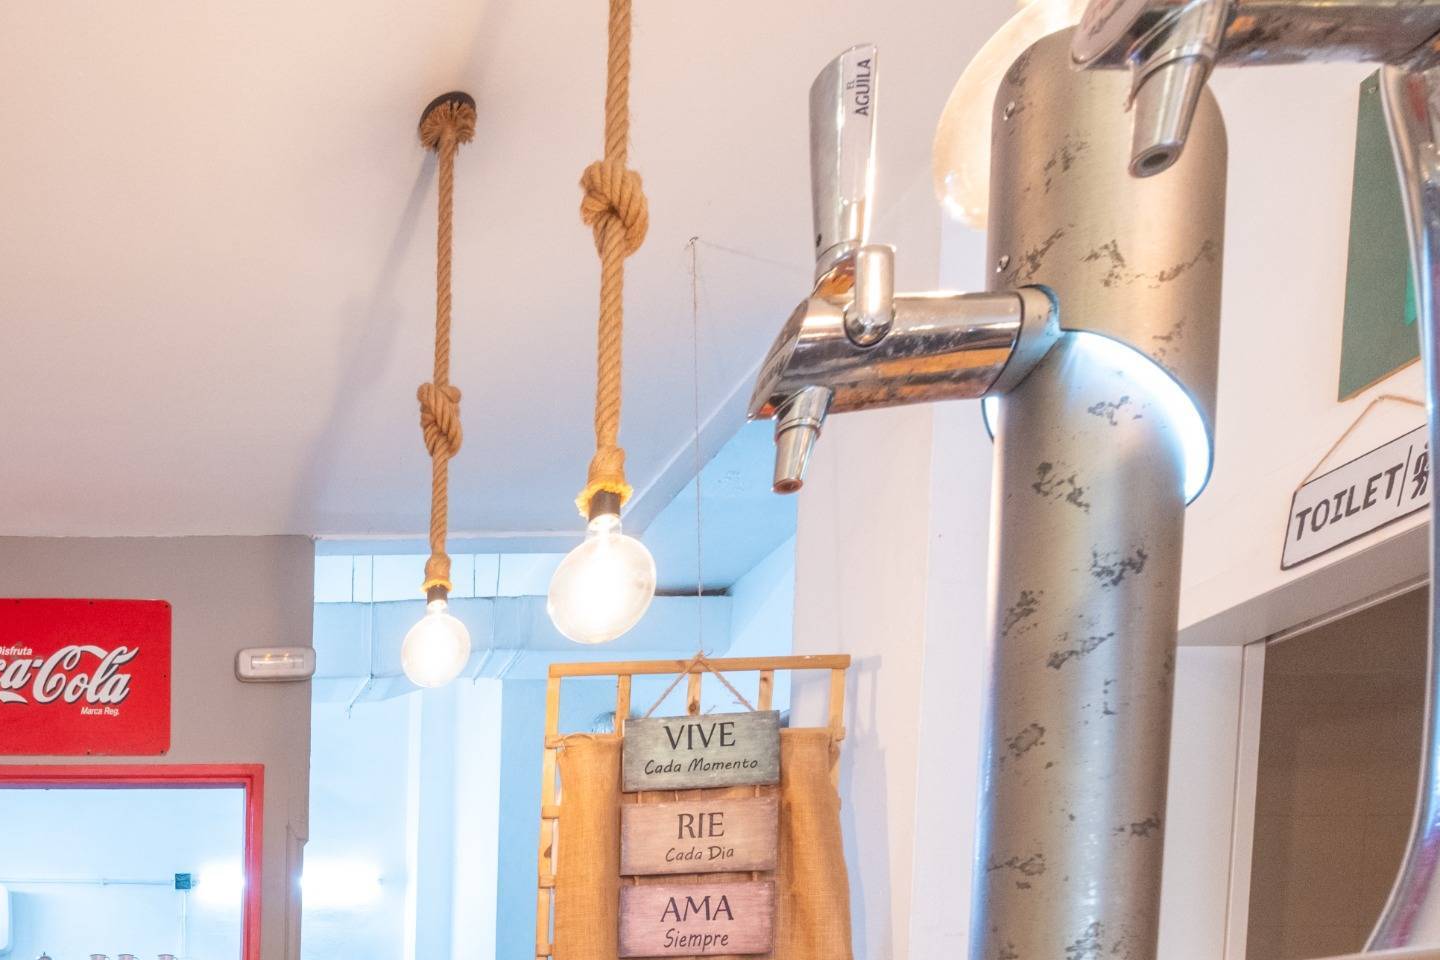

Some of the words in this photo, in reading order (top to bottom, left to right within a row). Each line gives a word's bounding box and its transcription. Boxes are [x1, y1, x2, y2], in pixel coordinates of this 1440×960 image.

[855, 58, 872, 117] AGUILA
[80, 706, 103, 716] Marca
[104, 706, 120, 716] Reg.
[663, 721, 736, 751] VIVE
[644, 760, 681, 776] Cada
[687, 757, 759, 773] Momento
[677, 811, 725, 840] RIE
[665, 847, 703, 863] Cada
[708, 845, 735, 861] Dia
[660, 894, 735, 923] AMA
[663, 927, 729, 953] Siempre
